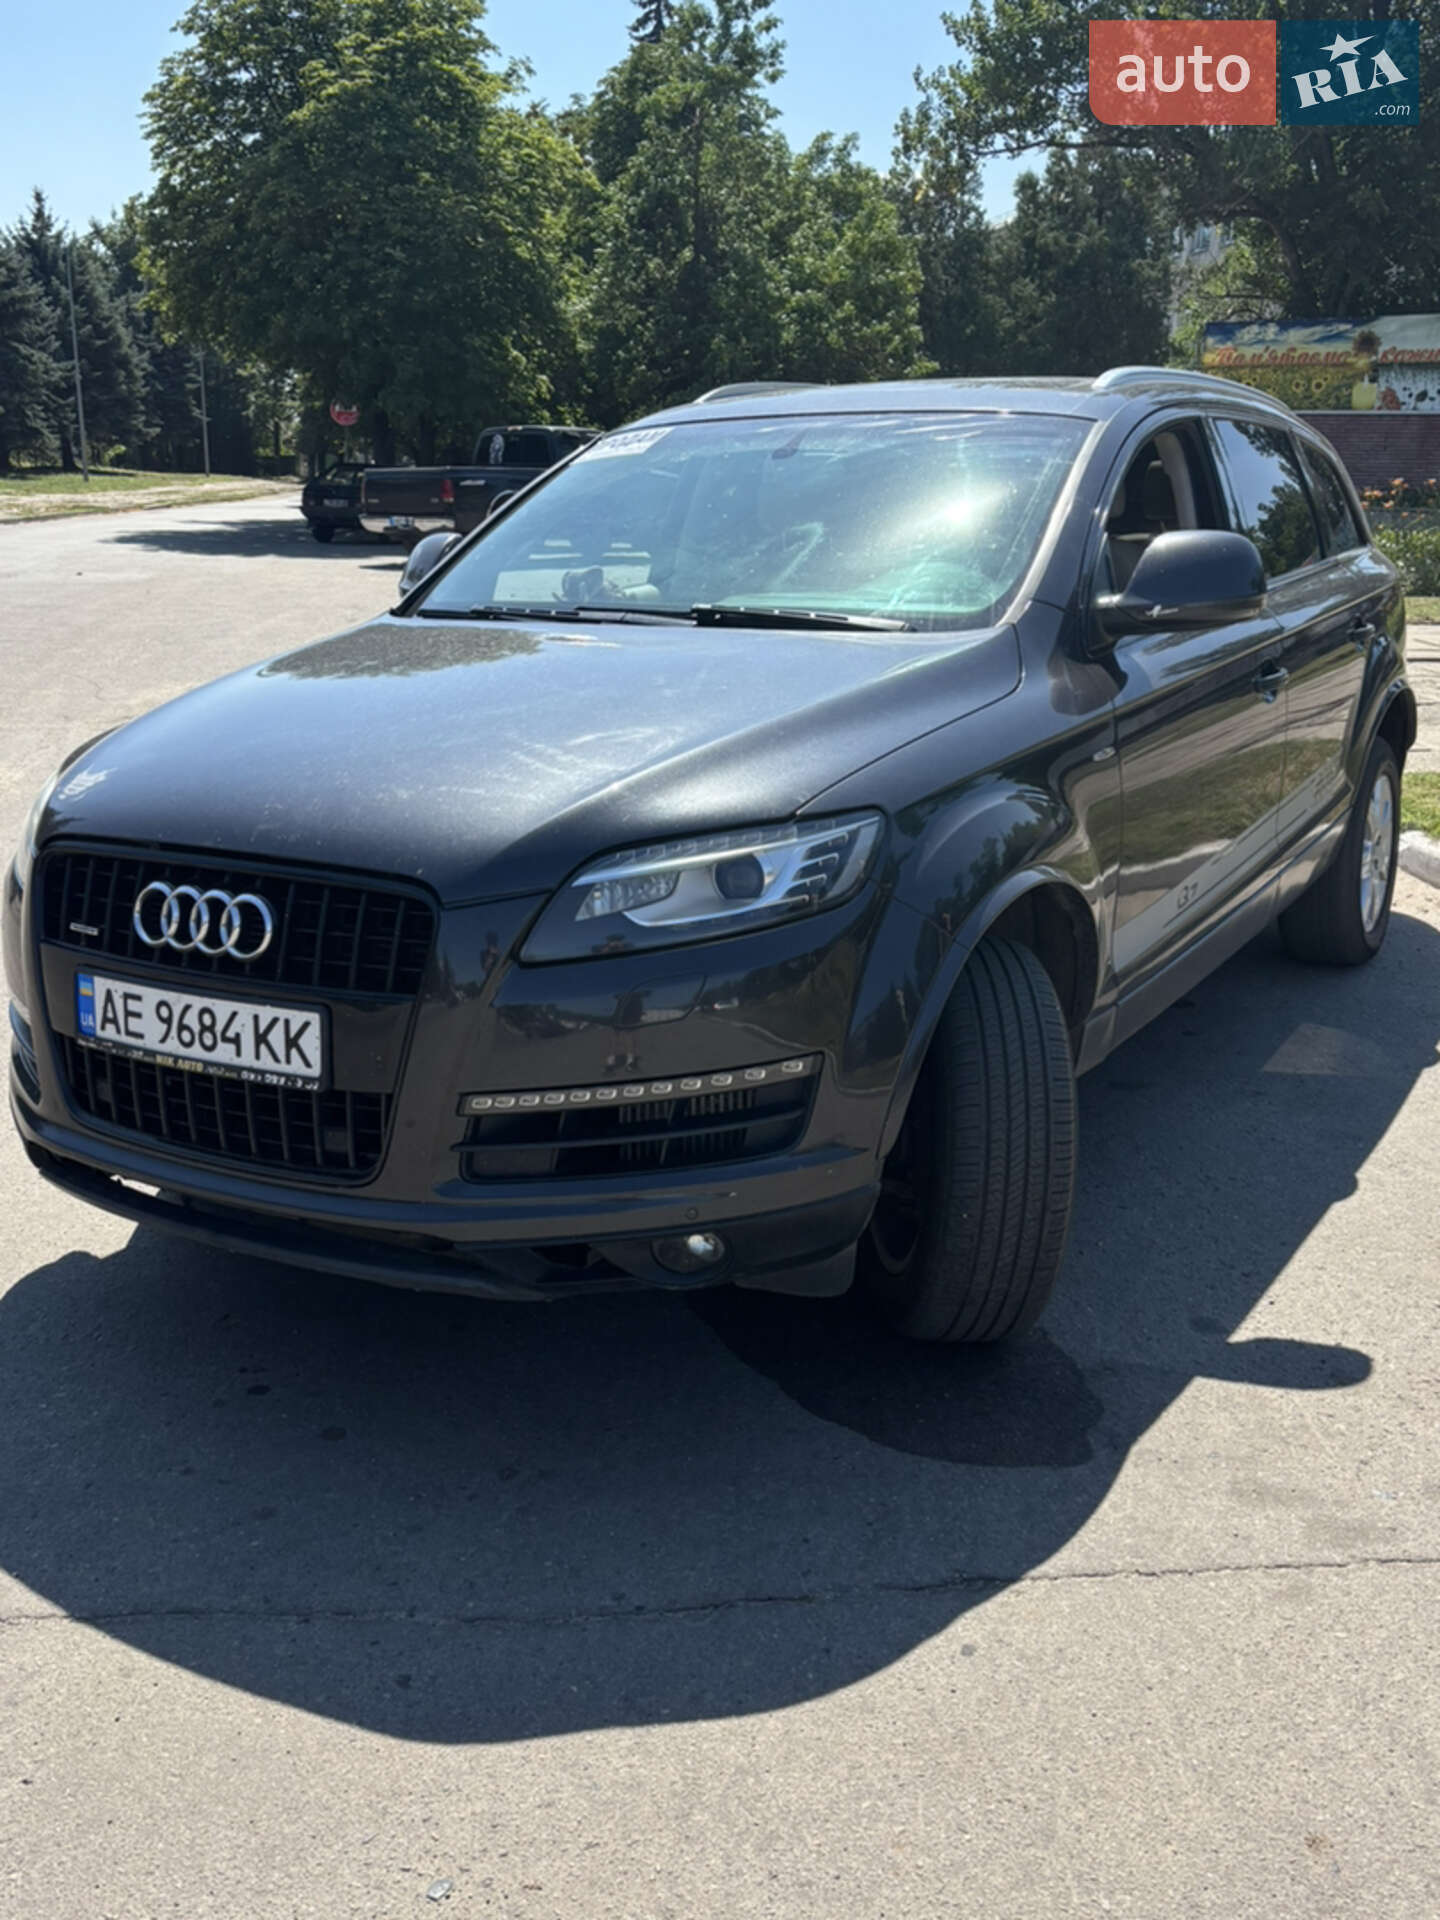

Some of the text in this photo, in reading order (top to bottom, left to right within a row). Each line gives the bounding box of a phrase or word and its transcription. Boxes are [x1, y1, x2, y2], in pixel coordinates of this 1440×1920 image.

[80, 1011, 95, 1026] UA
[101, 988, 145, 1040] AE
[155, 1000, 242, 1057] 9684
[252, 1013, 313, 1069] KK
